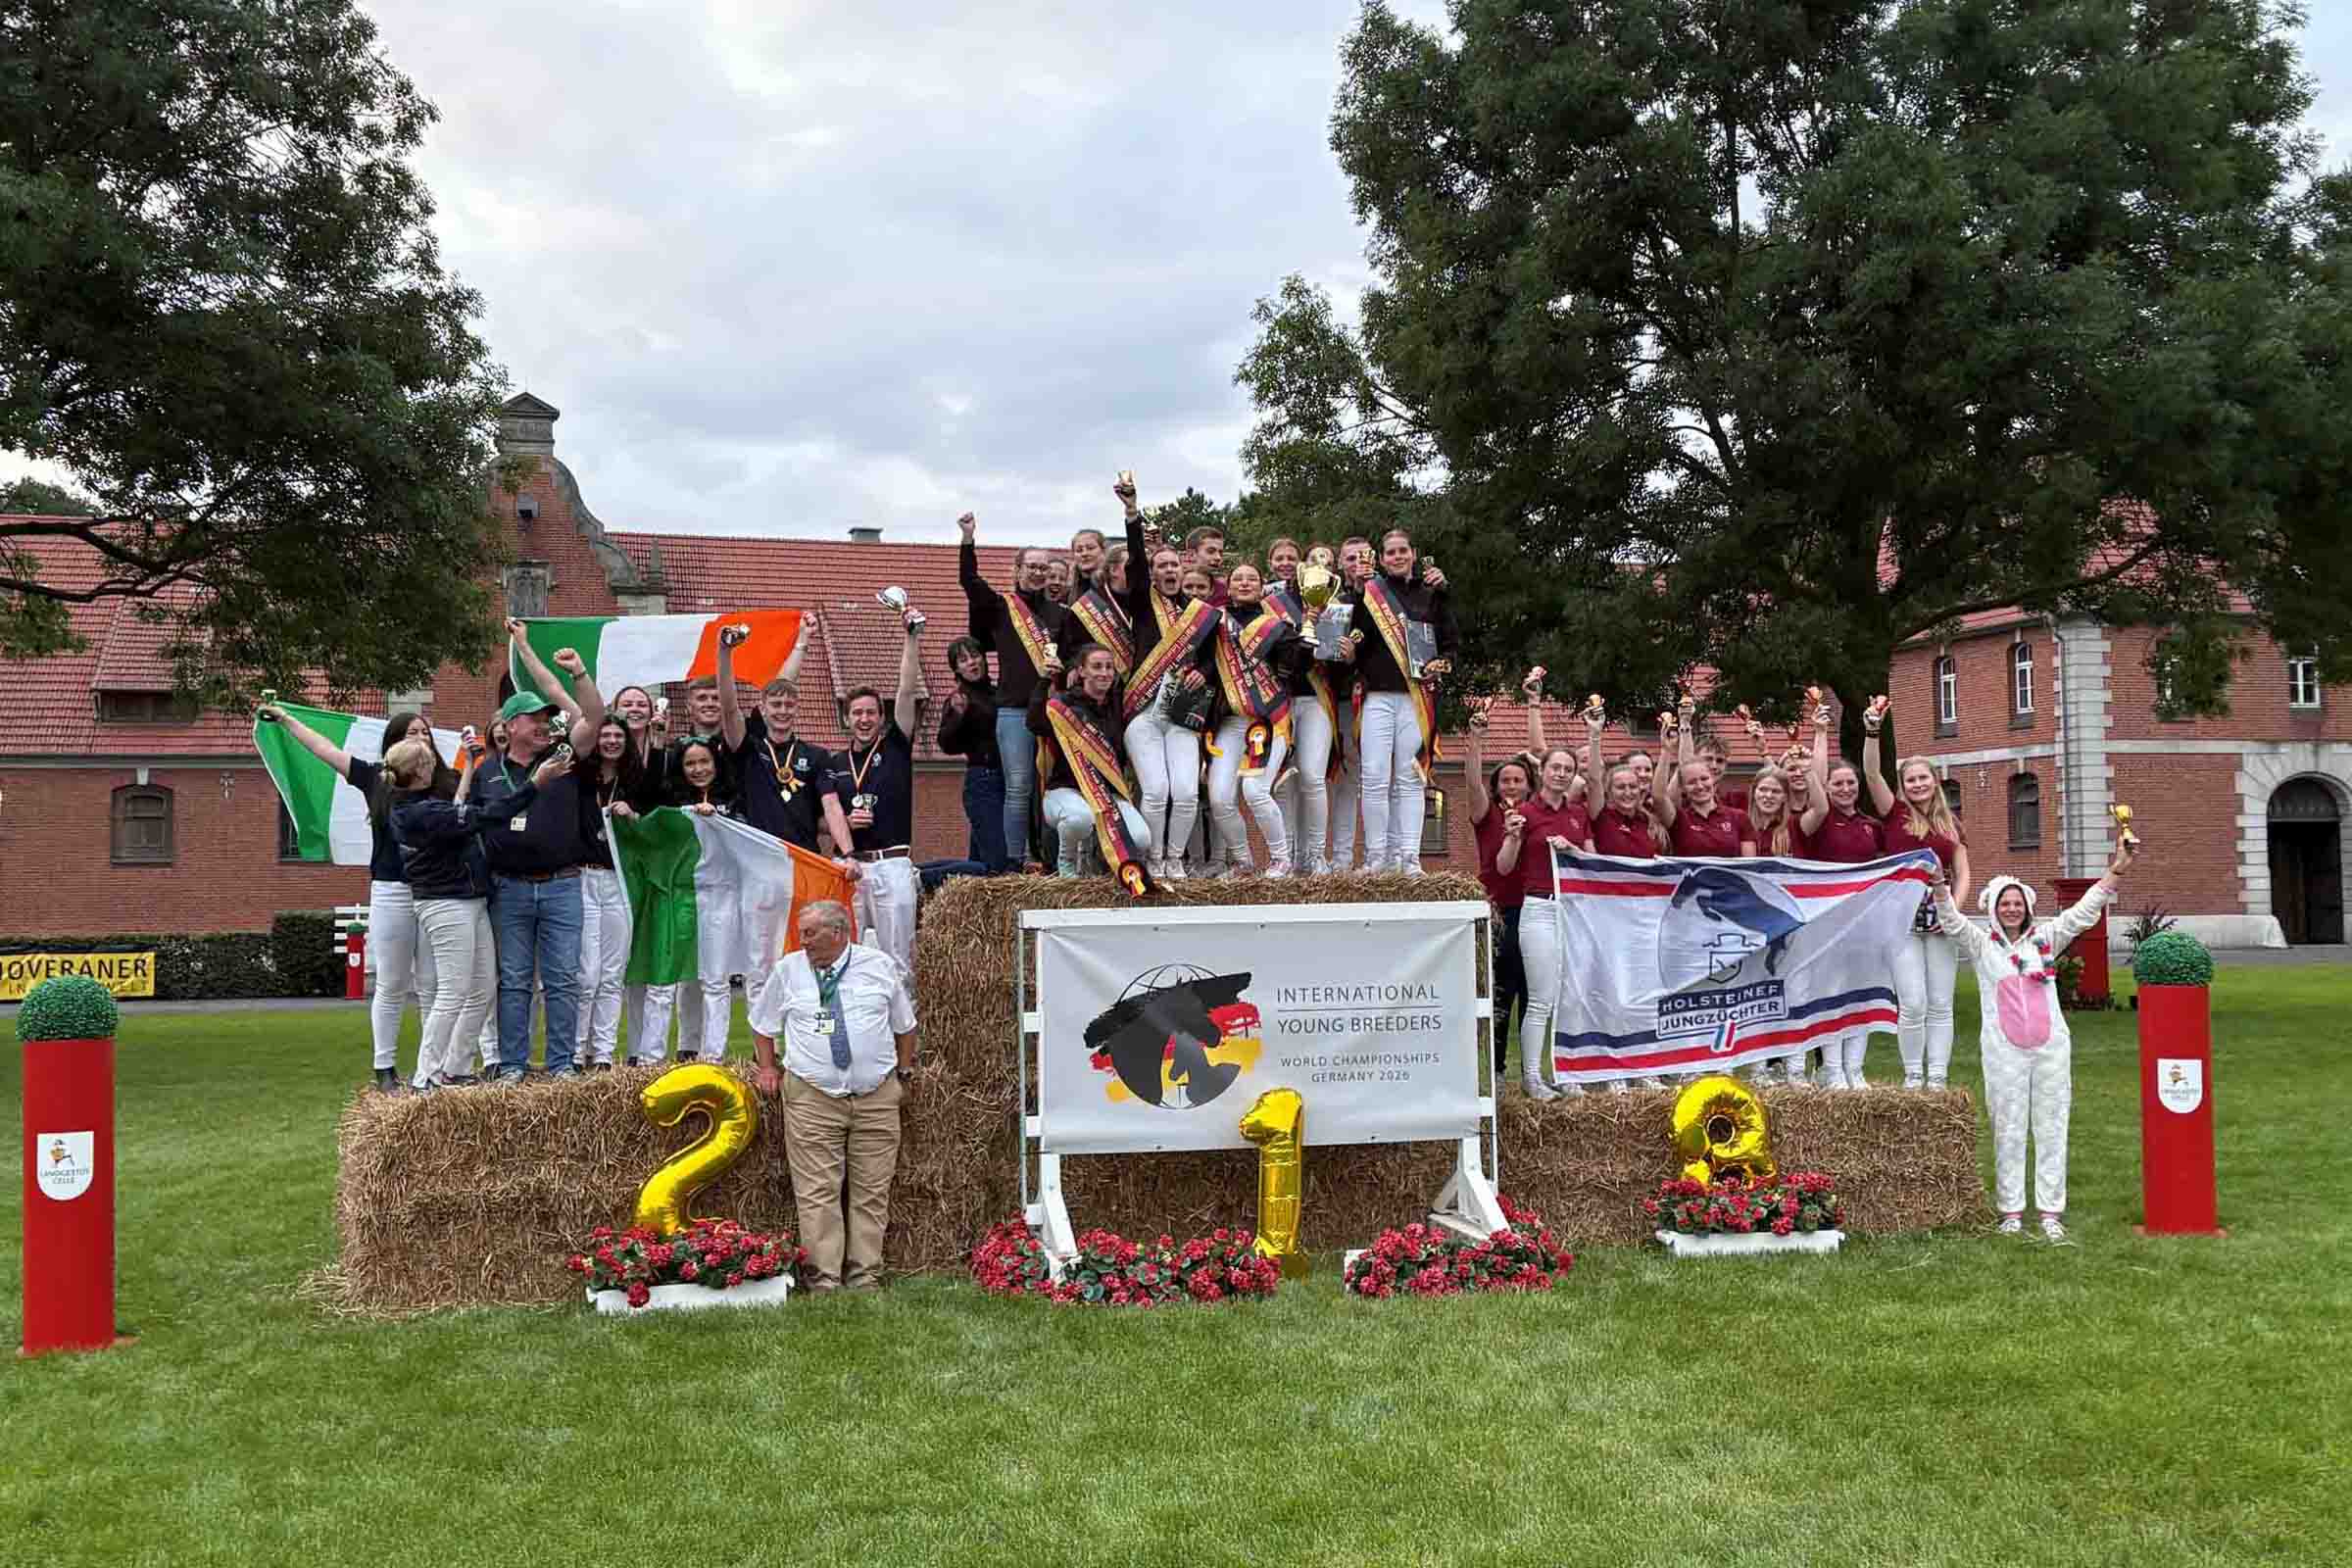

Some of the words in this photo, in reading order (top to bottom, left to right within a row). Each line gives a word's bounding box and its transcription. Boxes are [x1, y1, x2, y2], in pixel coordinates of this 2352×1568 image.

[0, 958, 147, 980] OVERANER
[1277, 984, 1441, 1004] INTERNATIONAL
[1277, 1017, 1345, 1035] YOUNG
[1350, 1014, 1443, 1033] BREEDERS
[1662, 1000, 1780, 1031] JUNGZÜCHTER
[1280, 1055, 1327, 1068] WORLD
[1332, 1052, 1441, 1068] CHAMPIONSHIPS
[1310, 1071, 1374, 1083] GERMANY
